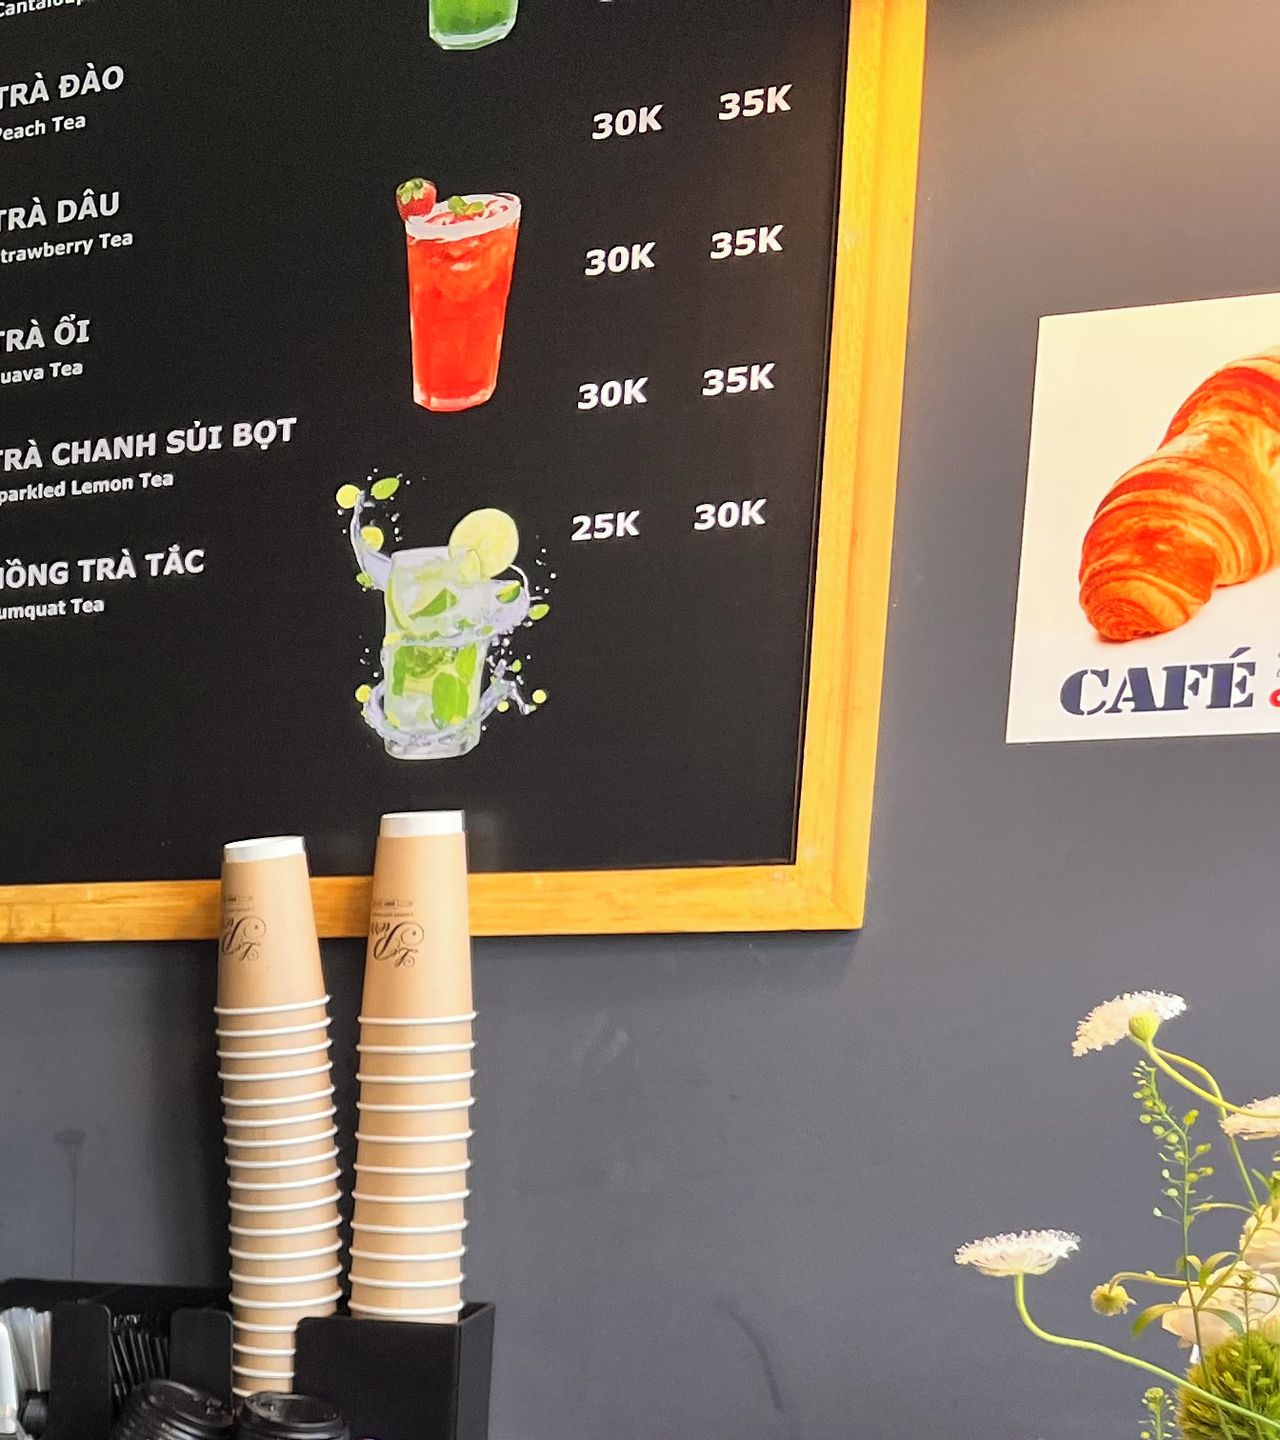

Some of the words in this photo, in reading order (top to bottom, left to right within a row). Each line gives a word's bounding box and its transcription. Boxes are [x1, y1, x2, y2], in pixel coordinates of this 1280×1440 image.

[59, 63, 123, 98] ĐÀO
[719, 84, 792, 120] 35K
[52, 116, 85, 132] Tea
[592, 105, 663, 139] 30K
[58, 189, 119, 223] DÂU
[99, 233, 132, 248] Tea
[711, 225, 783, 259] 35K
[585, 242, 655, 275] 30K
[49, 362, 83, 377] Tea
[703, 363, 775, 395] 35K
[578, 377, 648, 409] 30K
[52, 433, 156, 466] CHANH
[167, 421, 222, 453] SỦI
[233, 417, 297, 450] BỌT
[72, 478, 133, 495] Lemon
[139, 473, 173, 488] Tea
[572, 510, 639, 541] 25K
[694, 499, 766, 530] 30K
[78, 549, 136, 582] TRÀ
[145, 544, 204, 576] TẮC
[70, 598, 104, 613] Tea
[1059, 647, 1258, 716] CAFÉ
